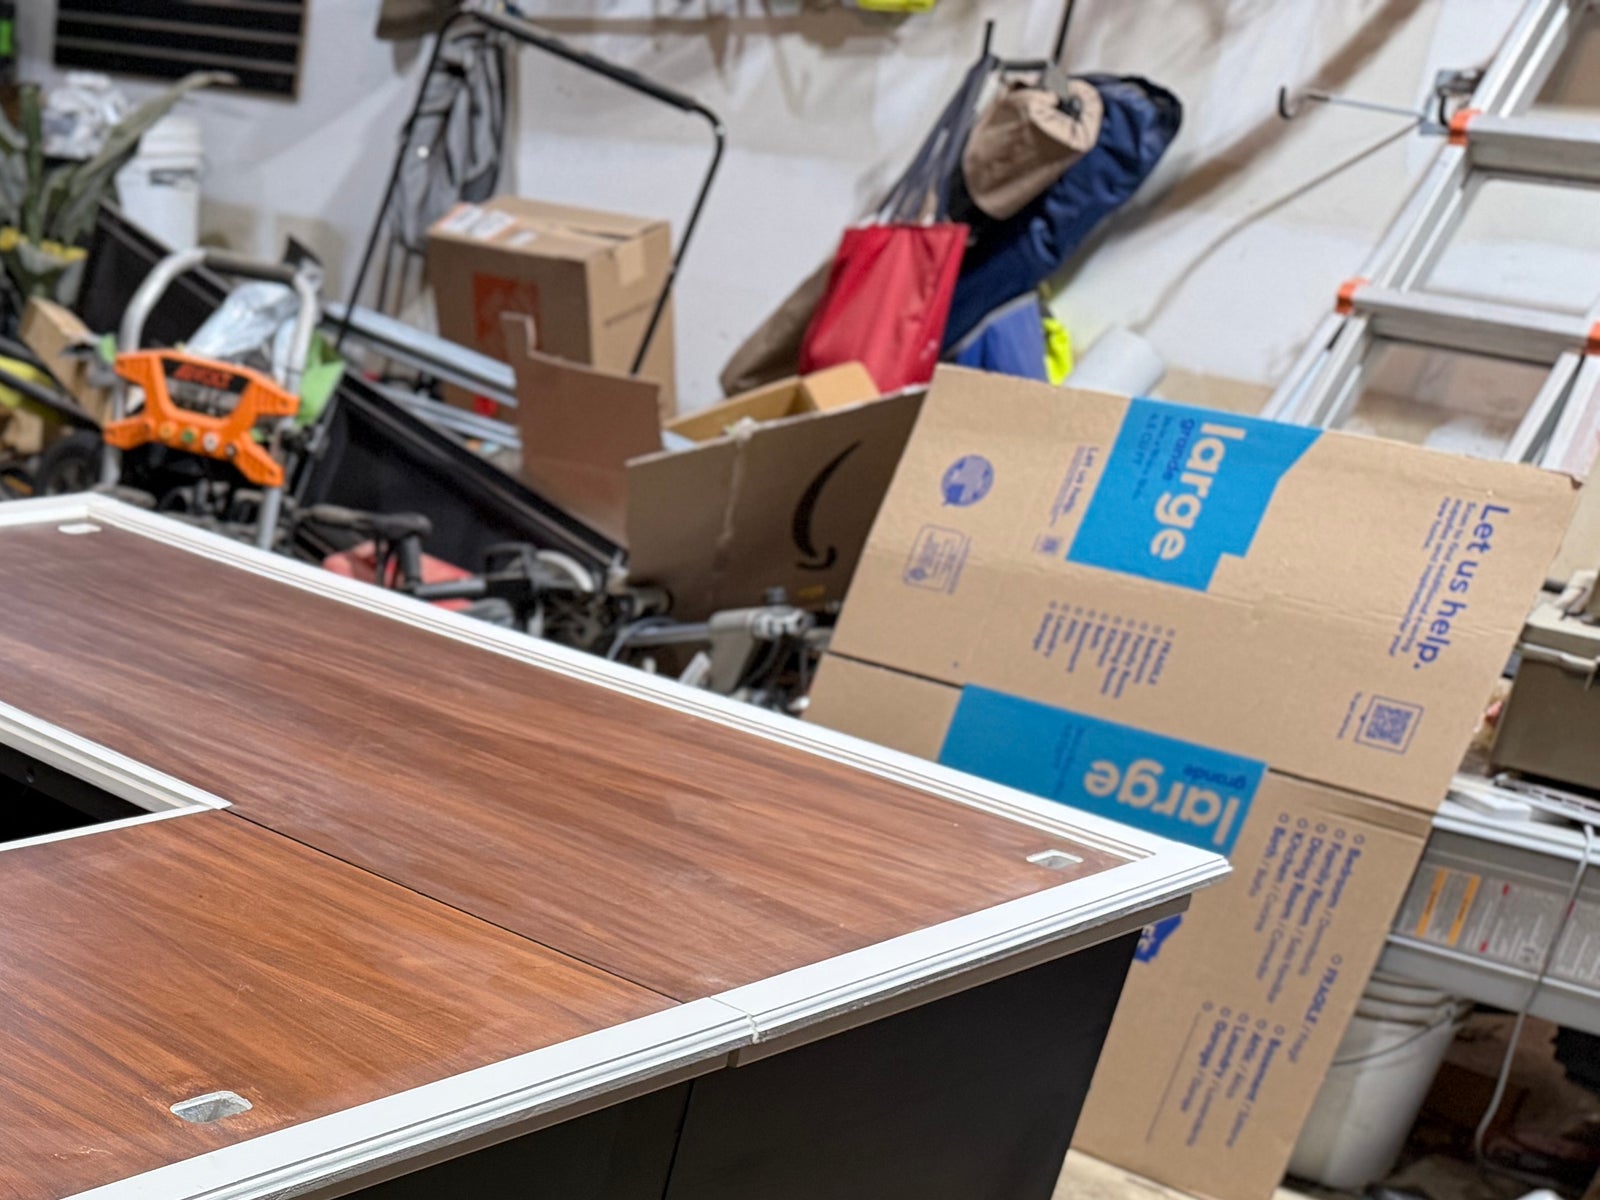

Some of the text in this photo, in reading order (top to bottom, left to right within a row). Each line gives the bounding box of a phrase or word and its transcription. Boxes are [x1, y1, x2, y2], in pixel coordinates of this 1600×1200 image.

[1161, 418, 1199, 483] grande
[1150, 422, 1247, 560] large
[1414, 504, 1510, 670] Let us help.
[1033, 612, 1054, 651] Garage
[1045, 616, 1064, 657] Laundry
[1065, 620, 1078, 642] Attic
[1068, 621, 1093, 672] Basement
[1091, 625, 1105, 649] Bath
[1098, 628, 1119, 666] Kitchen
[1102, 631, 1132, 695] Dining Room
[1113, 635, 1145, 699] Family Room
[1135, 637, 1158, 684] Bedroom
[1148, 642, 1172, 686] FRAGILE
[1182, 763, 1247, 793] grande
[1083, 758, 1241, 847] large
[1266, 827, 1286, 858] Bath
[1277, 832, 1304, 882] Kitchen
[1293, 838, 1323, 881] Dining
[1315, 842, 1343, 887] Family
[1283, 882, 1305, 919] Room
[1328, 847, 1361, 908] Bedroom
[1300, 889, 1324, 926] Room
[1306, 968, 1338, 1024] FRAGILE
[1199, 1021, 1228, 1069] Garage
[1215, 1026, 1244, 1079] Laundry
[1242, 1033, 1261, 1063] Attic
[1246, 1038, 1282, 1103] Basement
